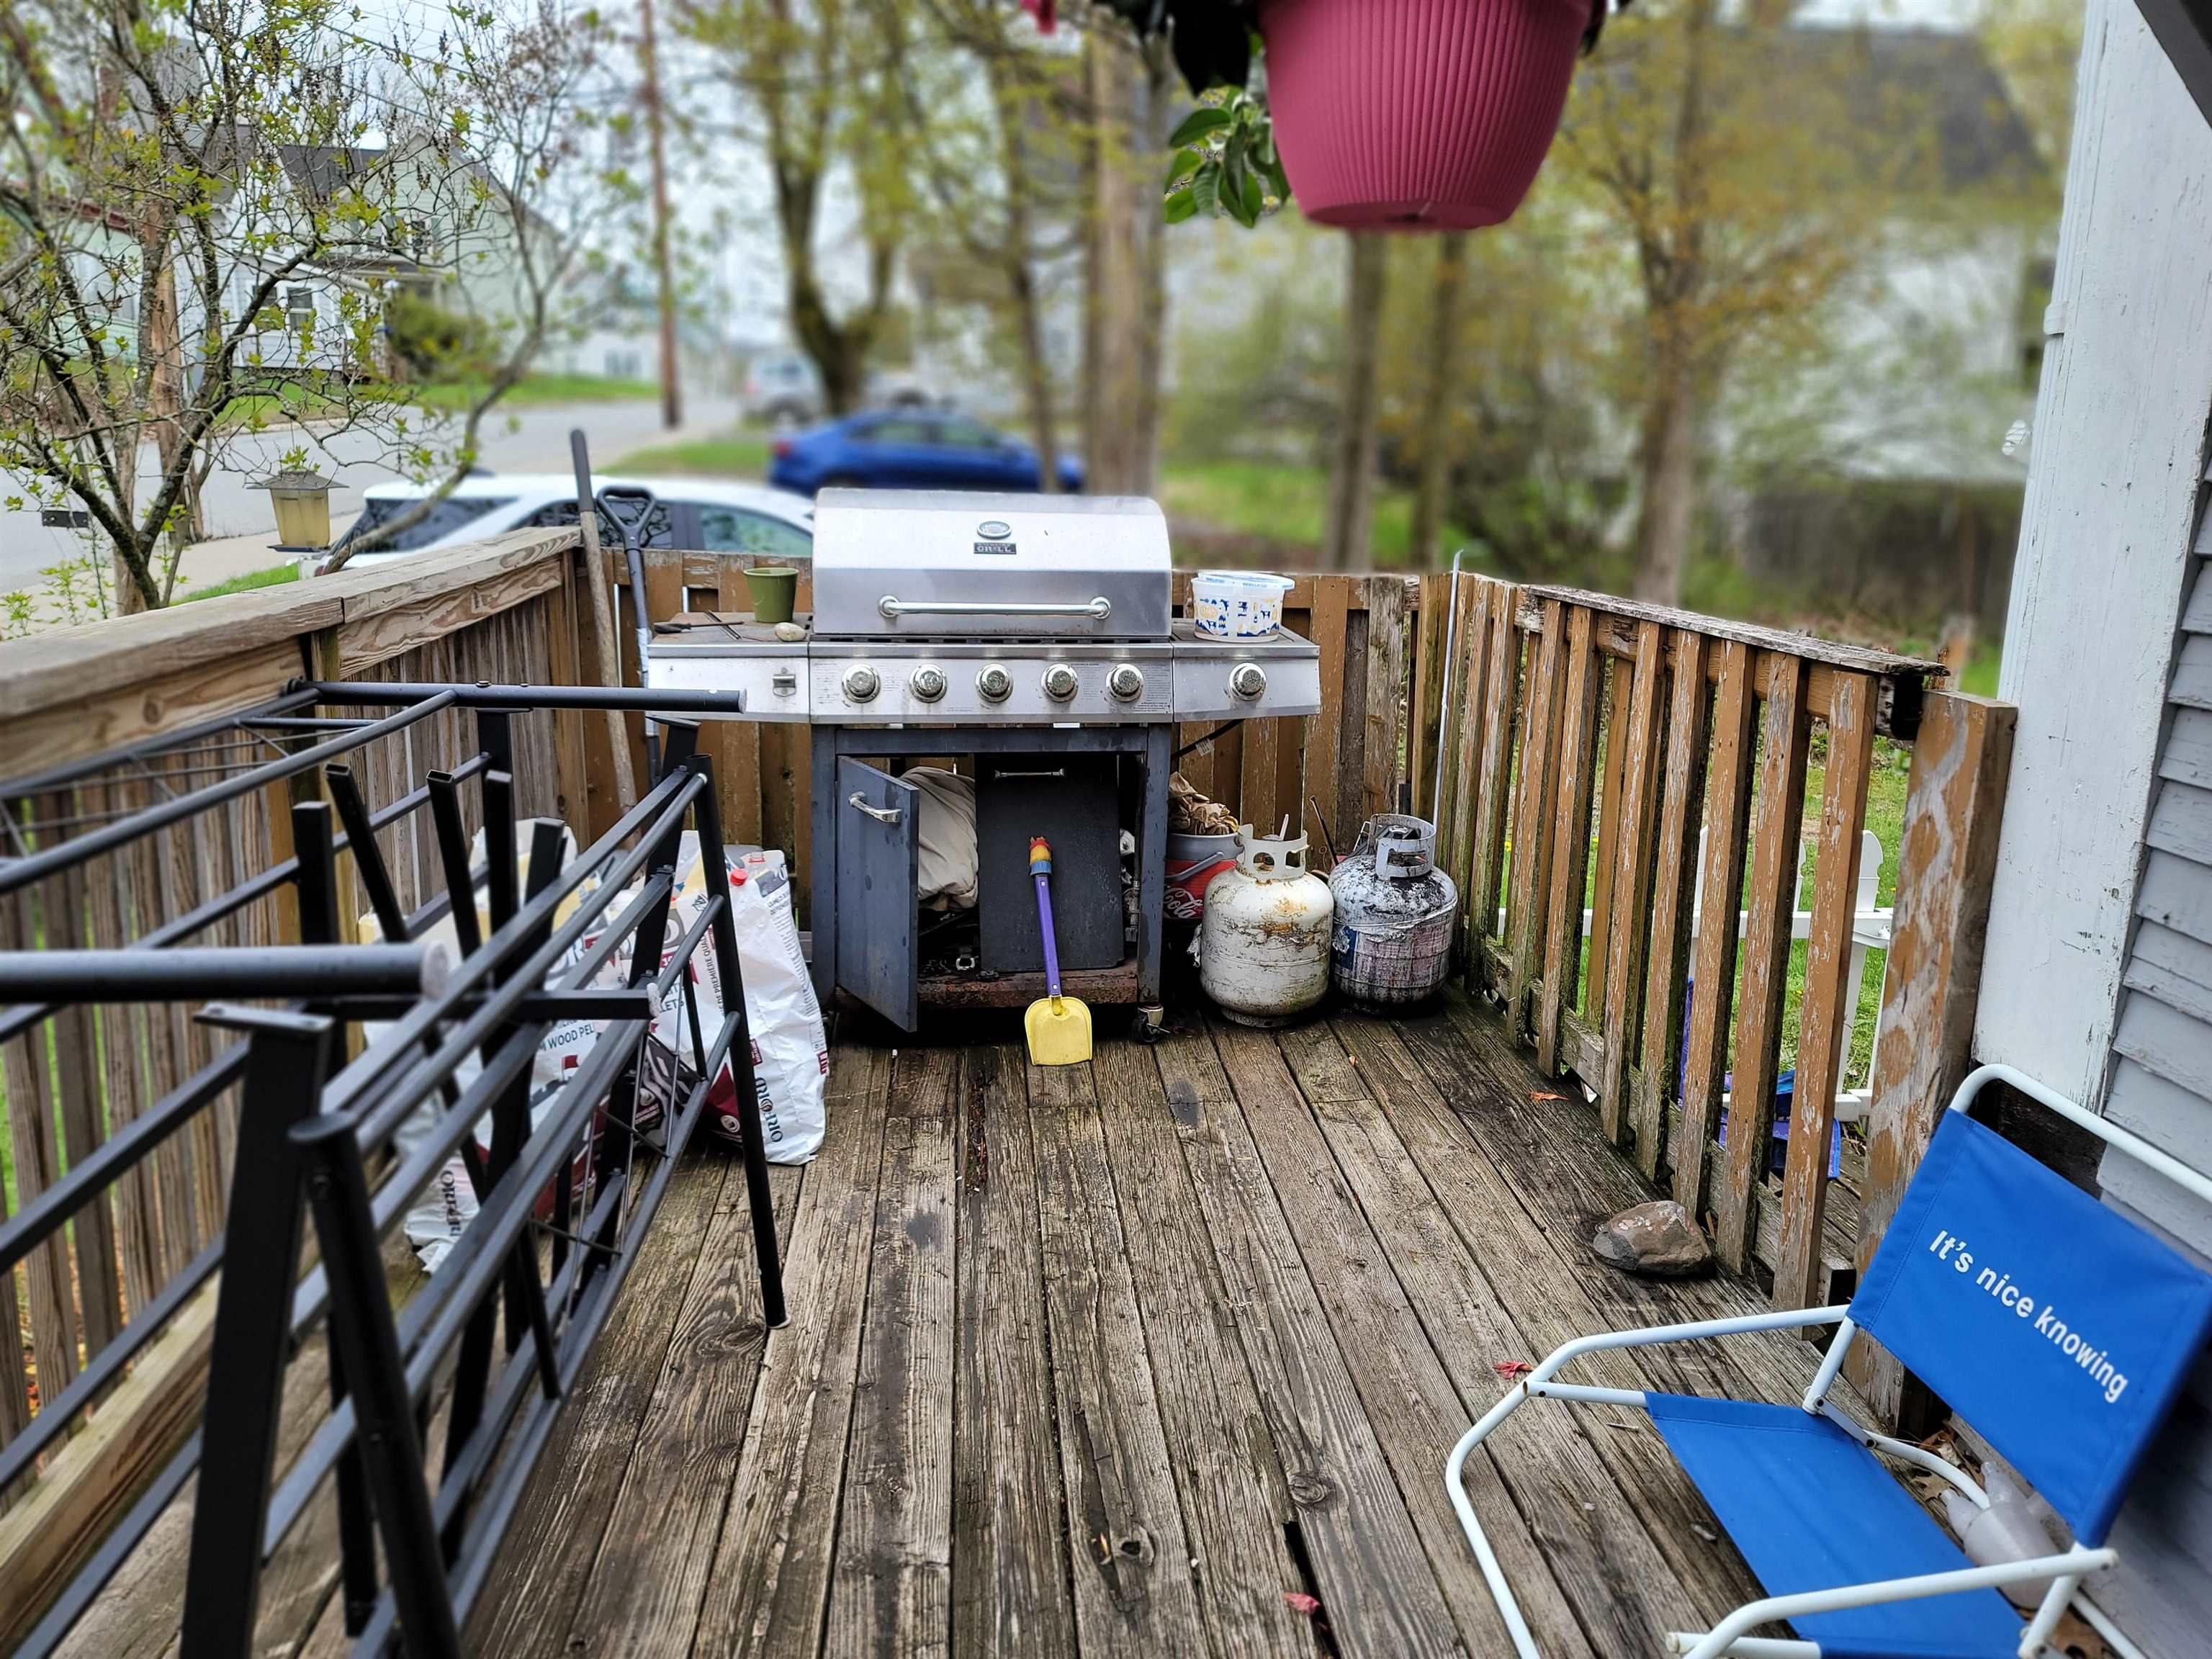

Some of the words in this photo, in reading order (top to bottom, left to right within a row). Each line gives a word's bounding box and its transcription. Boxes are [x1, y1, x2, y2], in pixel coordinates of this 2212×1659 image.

[700, 937, 710, 956] QUAL
[547, 1030, 578, 1049] WOOD
[578, 1023, 595, 1038] PEL
[1929, 1230, 1974, 1273] It's
[1976, 1266, 2034, 1318] nice
[2033, 1305, 2128, 1403] knowing
